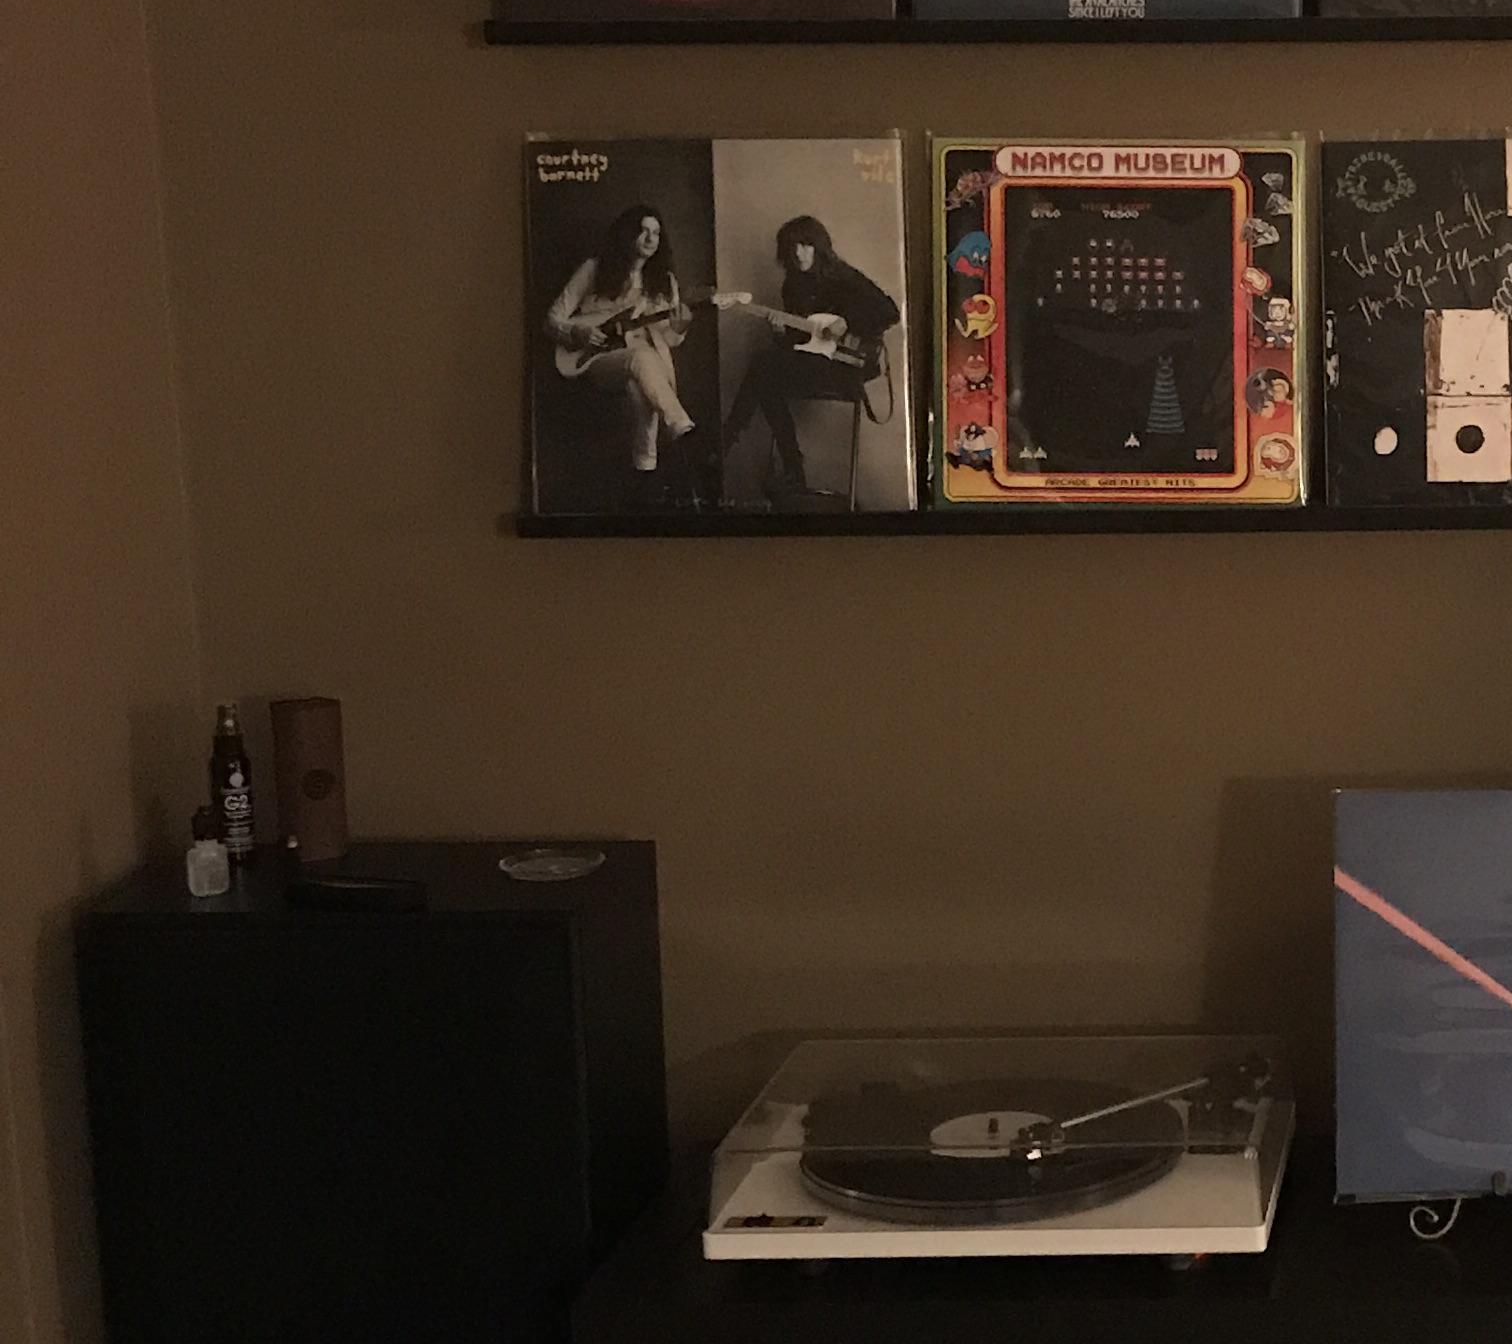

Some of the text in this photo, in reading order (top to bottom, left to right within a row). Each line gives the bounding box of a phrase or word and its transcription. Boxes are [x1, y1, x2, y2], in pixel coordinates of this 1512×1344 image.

[536, 147, 609, 172] courtney
[1010, 152, 1226, 174] NAMCO MUSEUM
[538, 166, 600, 183] barnett
[1165, 478, 1196, 487] HITS
